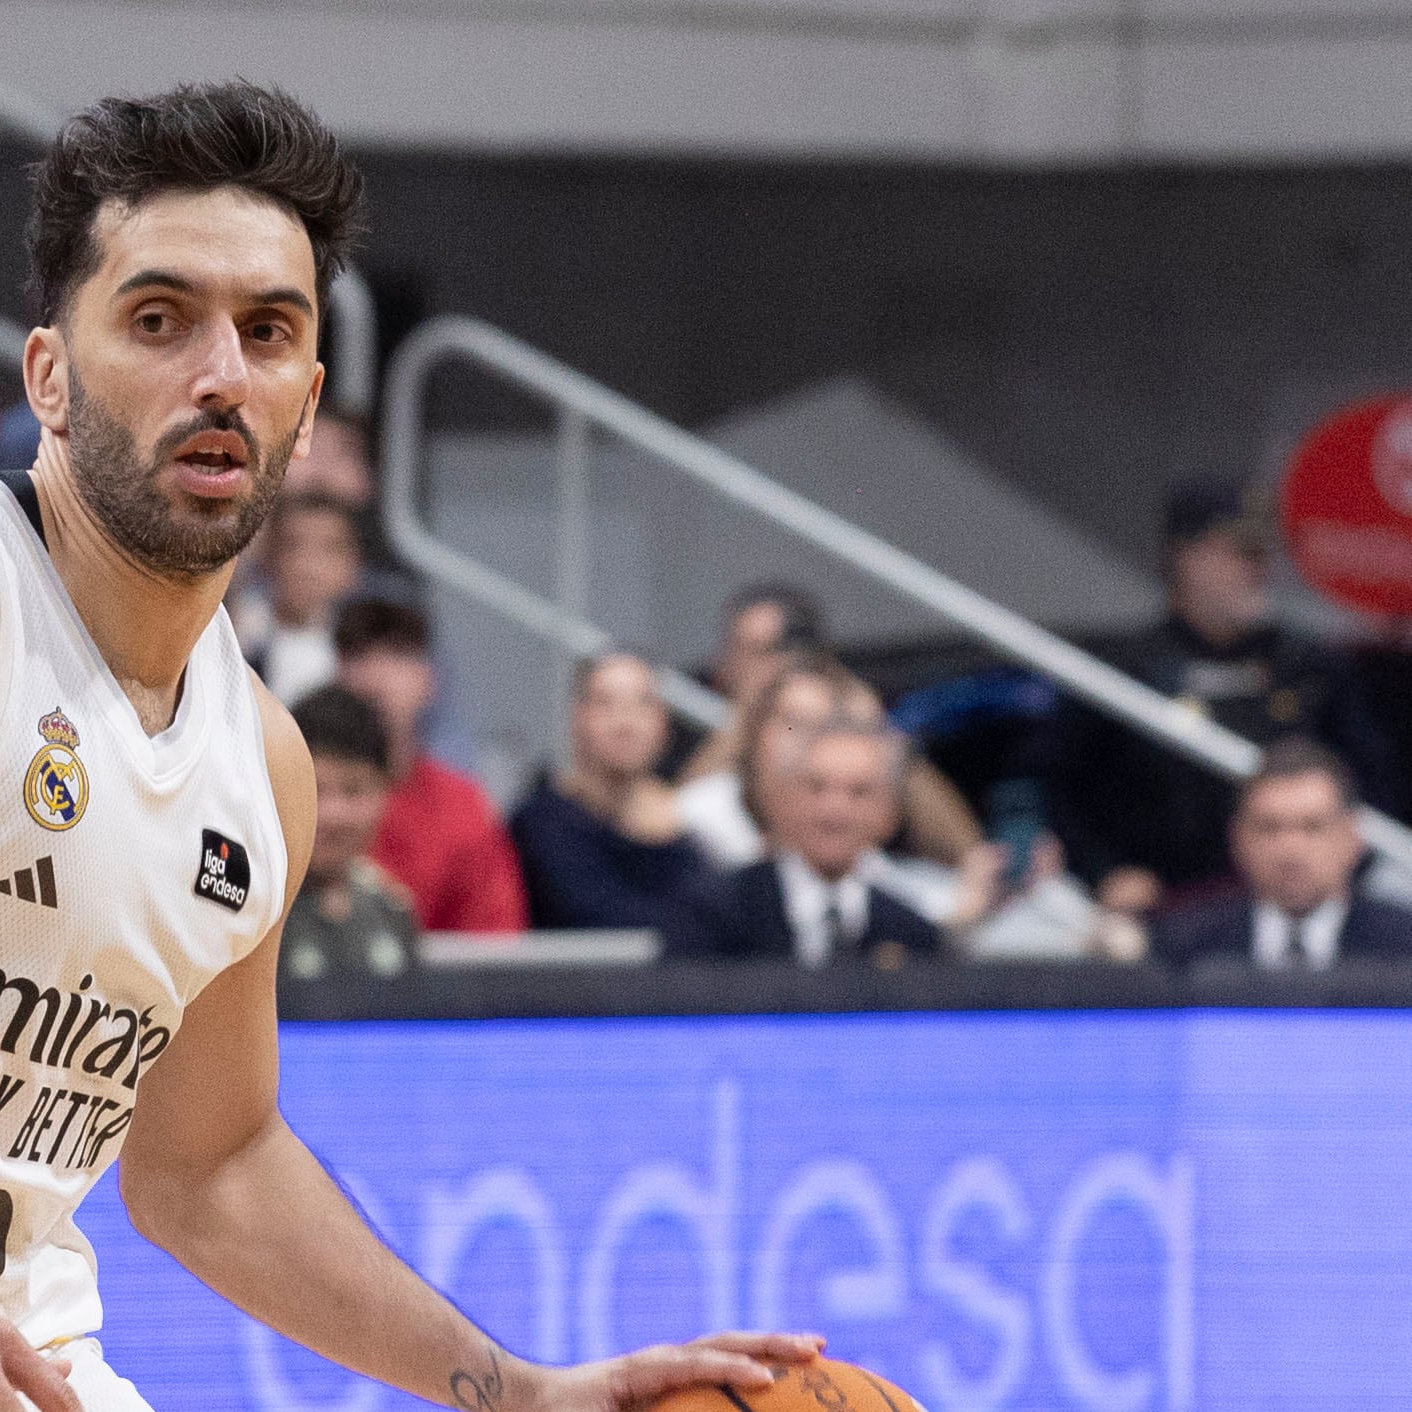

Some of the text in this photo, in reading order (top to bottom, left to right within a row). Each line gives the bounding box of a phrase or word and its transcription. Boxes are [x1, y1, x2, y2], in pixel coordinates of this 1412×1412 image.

[204, 849, 226, 875] liga
[201, 873, 245, 905] endesa
[9, 1087, 133, 1169] BETTER
